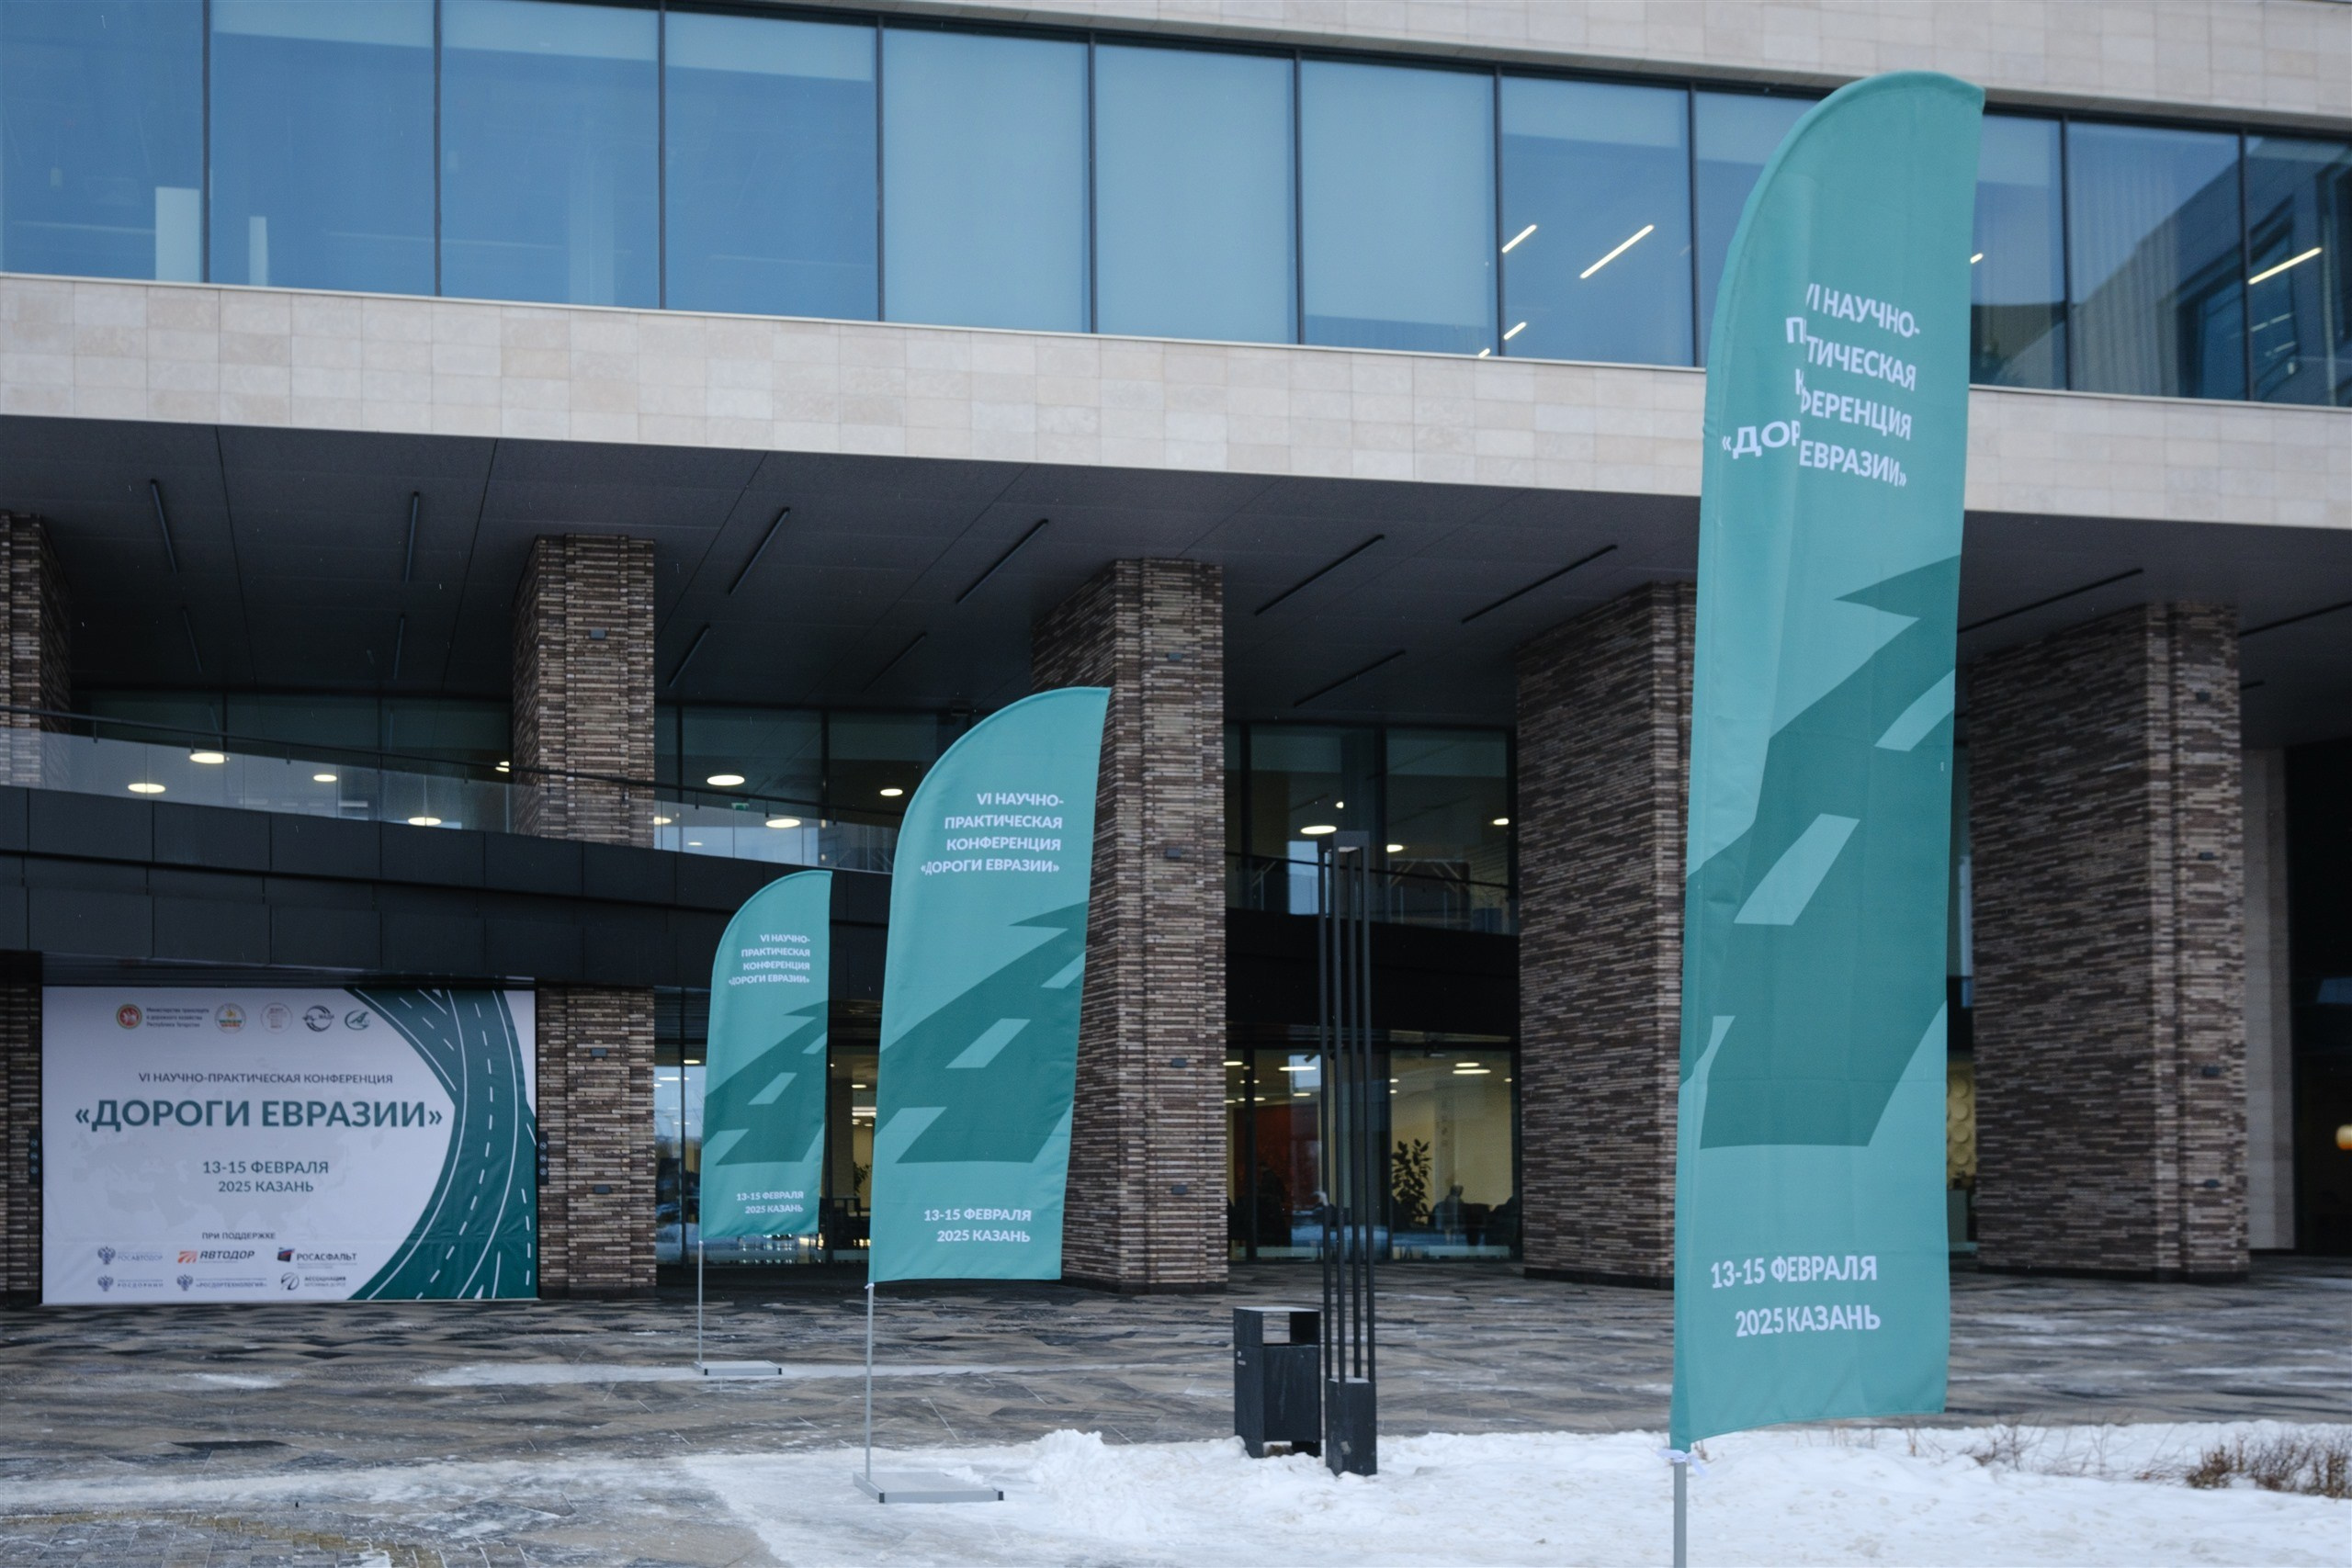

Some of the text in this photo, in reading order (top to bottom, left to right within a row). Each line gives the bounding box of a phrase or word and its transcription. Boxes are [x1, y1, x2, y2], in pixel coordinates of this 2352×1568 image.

[1824, 288, 1920, 338] НАУЧНО-
[1799, 440, 1906, 487] ЕВРАЗИИ»
[977, 793, 1064, 807] VI НАУЧНО-
[944, 815, 1063, 829] ПРАКТИЧЕСКАЯ
[946, 837, 1061, 852] КОНФЕРЕНЦИЯ
[921, 859, 1059, 875] «ДОРОГИ ЕВРАЗИИ»
[760, 934, 810, 943] VI НАУЧНО-
[741, 947, 810, 957] ПРАКТИЧЕСКАЯ
[743, 961, 810, 971] КОНФЕРЕНЦИЯ
[768, 974, 809, 984] ЕВРАЗИИ»
[138, 1072, 393, 1086] VI НАУЧНО-ПРАКТИЧЕСКАЯ КОНФЕРЕНЦИЯ
[74, 1099, 443, 1133] «ДОРОГИ ЕВРАЗИИ»
[202, 1160, 329, 1175] 13-15 ФЕВРАЛЯ
[219, 1180, 314, 1192] 2025 КАЗАНЬ
[736, 1190, 804, 1201] 13-15 ФЕВРАЛЯ
[745, 1204, 804, 1214] 2025 КАЗАНЬ
[923, 1208, 1032, 1222] 13-15 ФЕВРАЛЯ
[201, 1232, 276, 1241] ПРИ ПОДДЕРЖКЕ
[937, 1230, 1031, 1243] 2025 КАЗАНЬ
[199, 1250, 255, 1261] АВТОДОР
[296, 1252, 357, 1261] РОСАСФАЛЬТ
[1711, 1255, 1878, 1289] 13-15 ФЕВРАЛЯ
[1735, 1304, 1881, 1337] 2025 КАЗАНЬ
